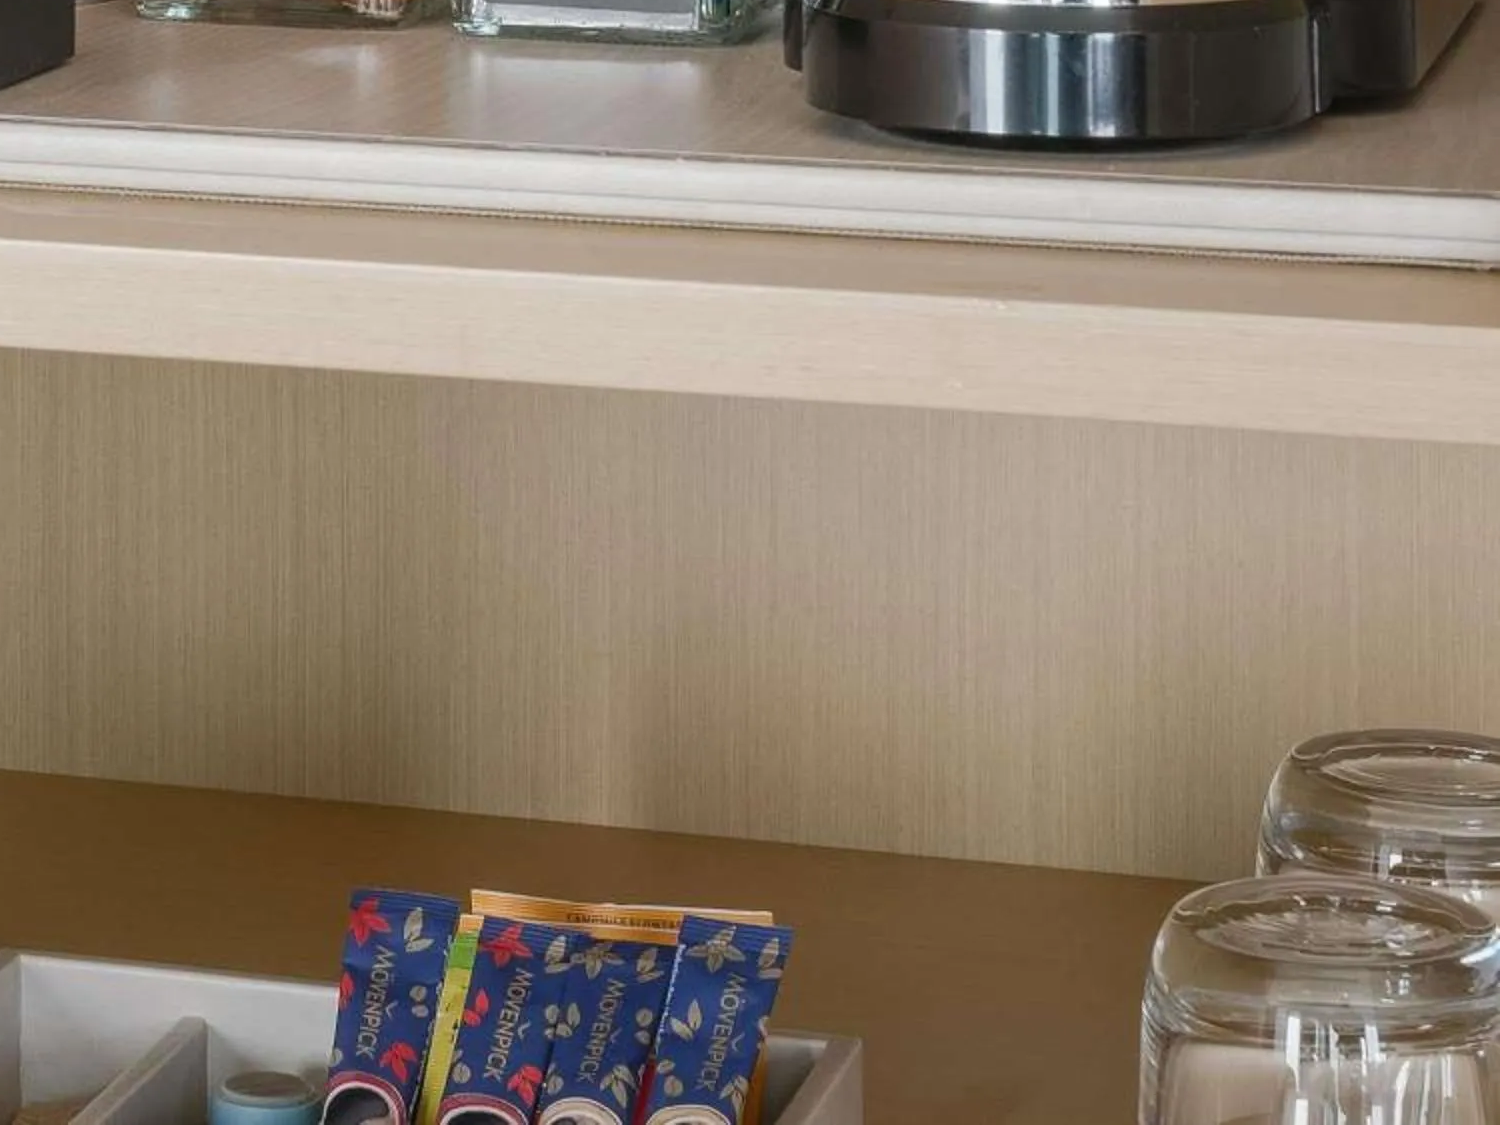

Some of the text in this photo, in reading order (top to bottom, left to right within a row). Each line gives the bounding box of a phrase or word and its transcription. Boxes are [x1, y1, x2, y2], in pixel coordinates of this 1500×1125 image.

[356, 945, 397, 1061] MÖVENPICK
[484, 967, 534, 1083] MÖVENPICK
[577, 978, 626, 1083] MÖVENPICK
[694, 973, 748, 1092] MÖVENPICK
